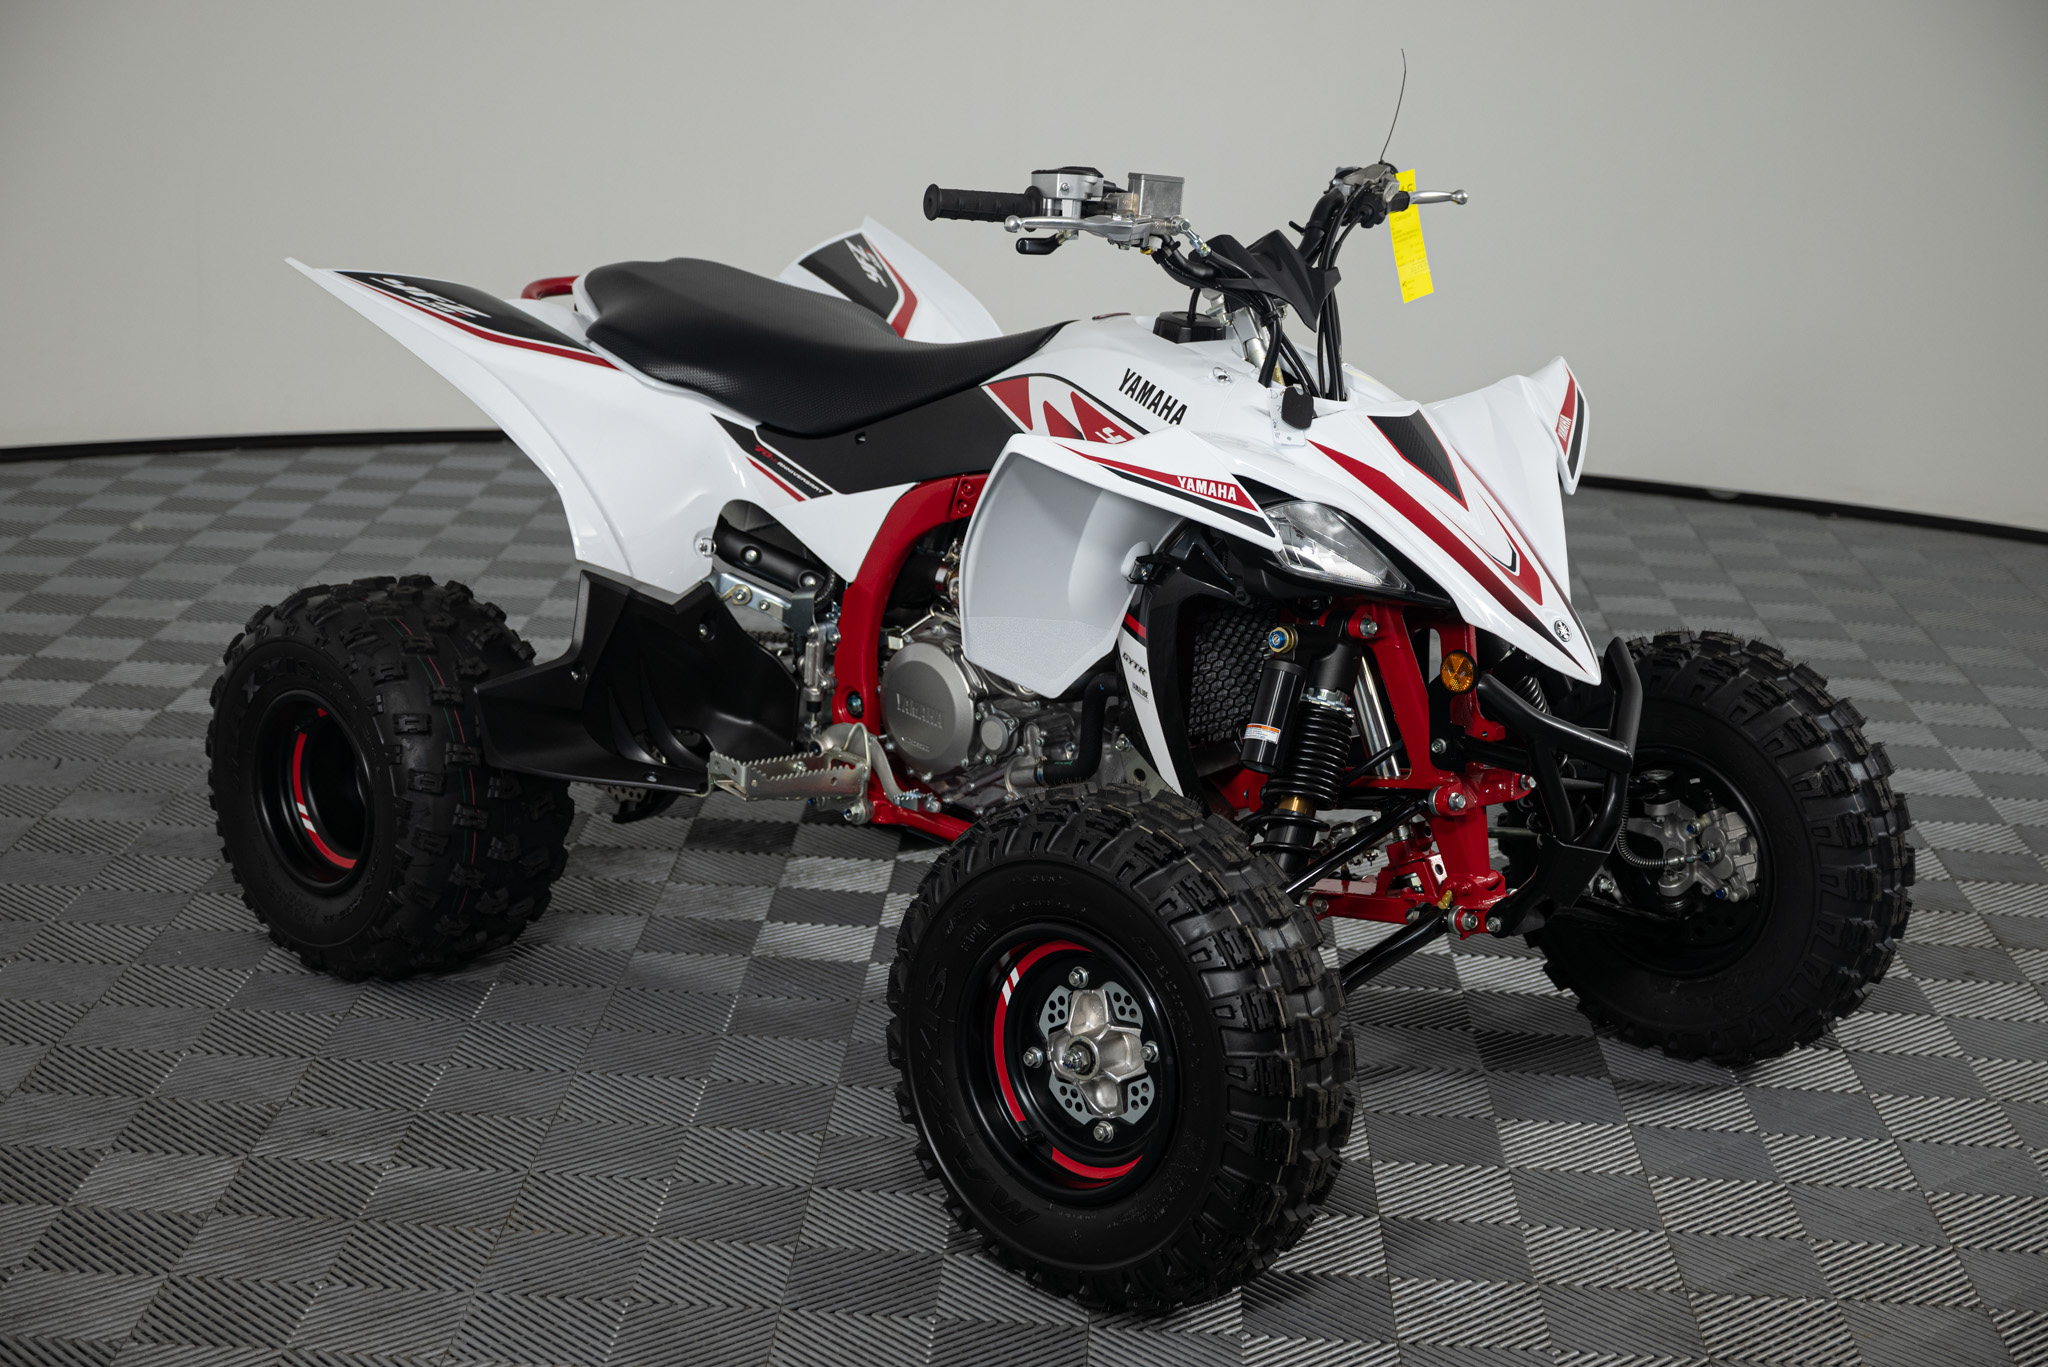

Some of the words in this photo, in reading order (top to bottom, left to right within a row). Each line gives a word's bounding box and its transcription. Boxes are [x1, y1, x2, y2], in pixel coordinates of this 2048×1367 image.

[1118, 368, 1188, 426] YAMAHA
[776, 461, 825, 494] ANNIVERSARY
[1177, 476, 1237, 502] YAMAHA
[1122, 652, 1148, 677] GYTR
